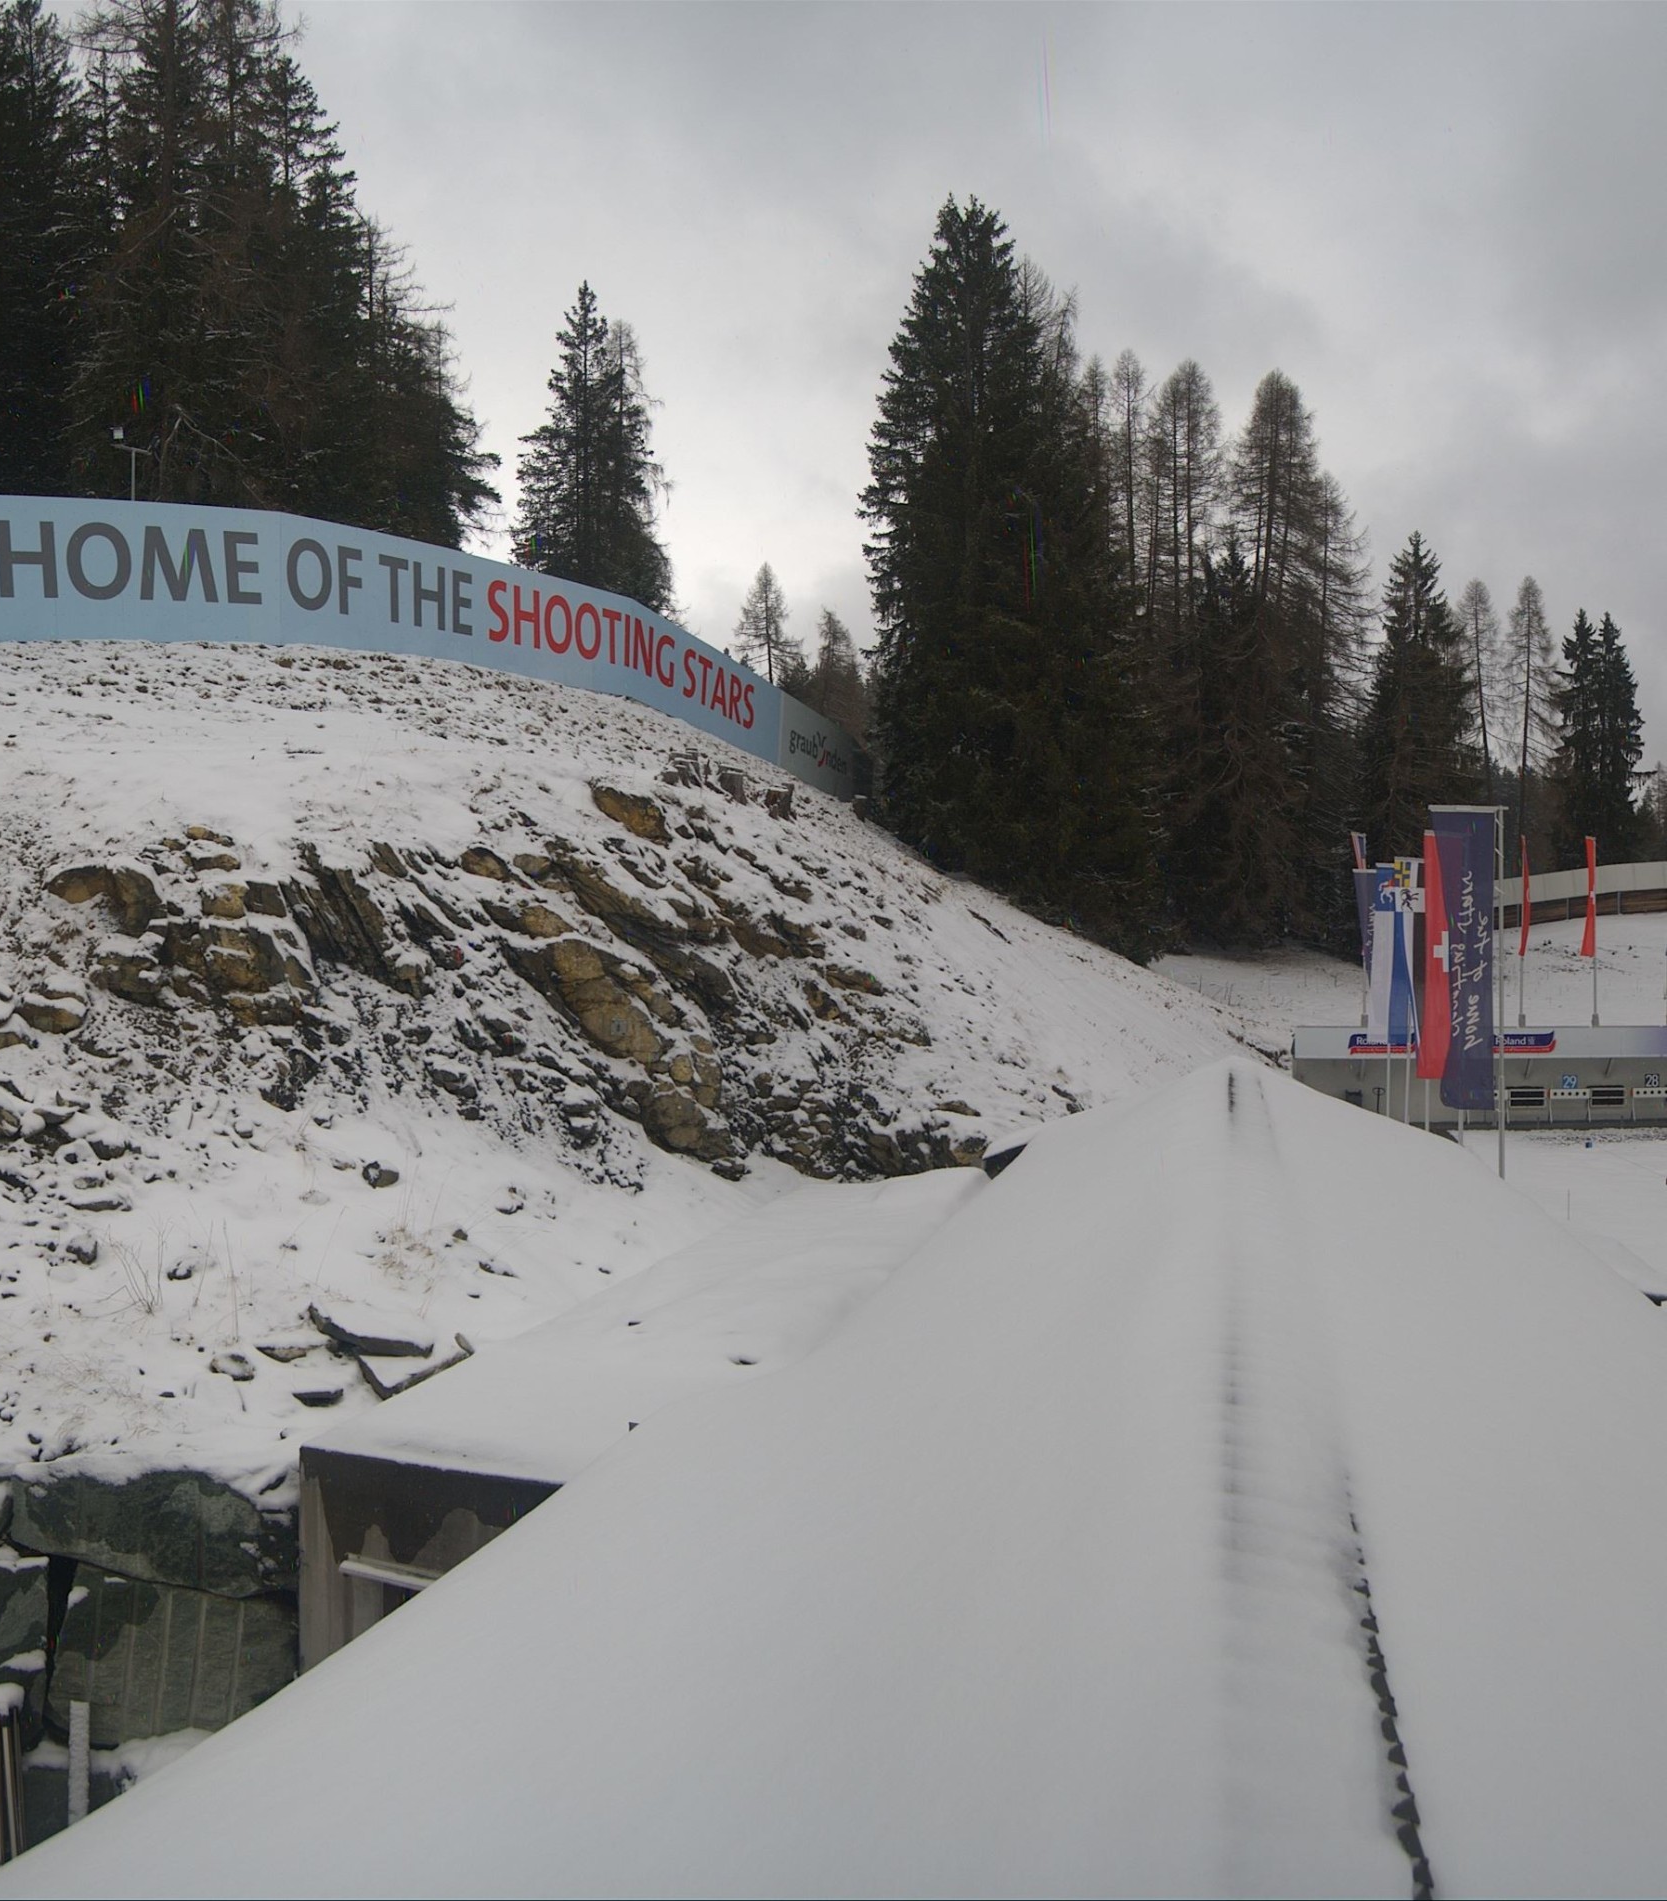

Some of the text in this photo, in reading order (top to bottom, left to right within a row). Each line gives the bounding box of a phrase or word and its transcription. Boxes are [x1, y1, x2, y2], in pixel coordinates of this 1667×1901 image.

[286, 538, 363, 616] OF
[378, 553, 473, 636] THE
[487, 579, 676, 688] SHOOTING
[683, 648, 756, 730] STARS
[1563, 1075, 1576, 1087] 29
[1645, 1074, 1658, 1086] 28
